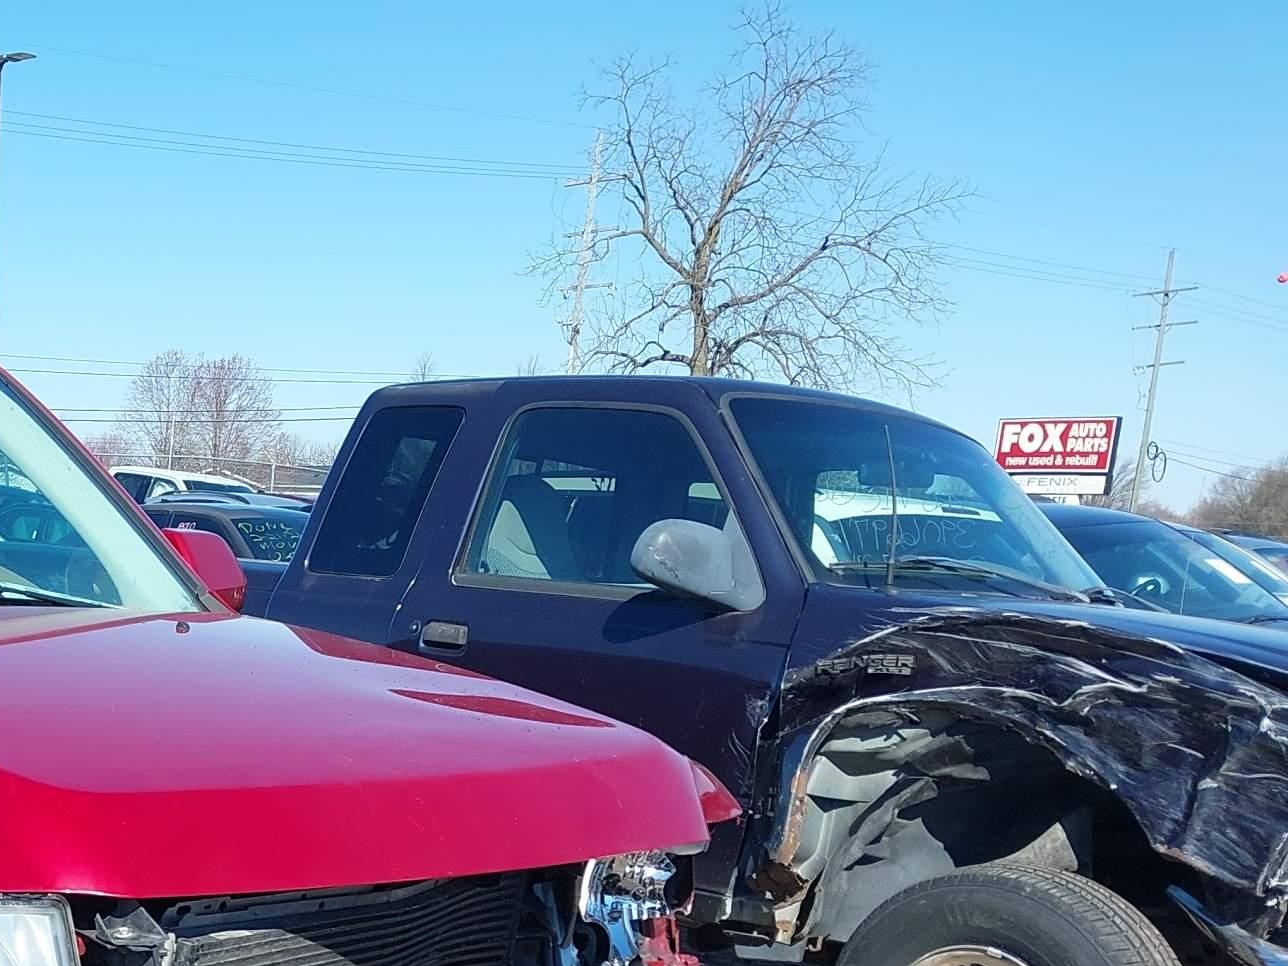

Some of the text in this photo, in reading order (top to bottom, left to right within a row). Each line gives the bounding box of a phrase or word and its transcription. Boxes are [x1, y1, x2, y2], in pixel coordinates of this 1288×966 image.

[1069, 422, 1106, 437] AUTO
[1000, 423, 1068, 453] FOX
[1066, 438, 1109, 452] PARTS
[1005, 454, 1098, 466] new used & rebuilt
[1026, 477, 1078, 487] FENIX
[815, 655, 916, 674] RANGER
